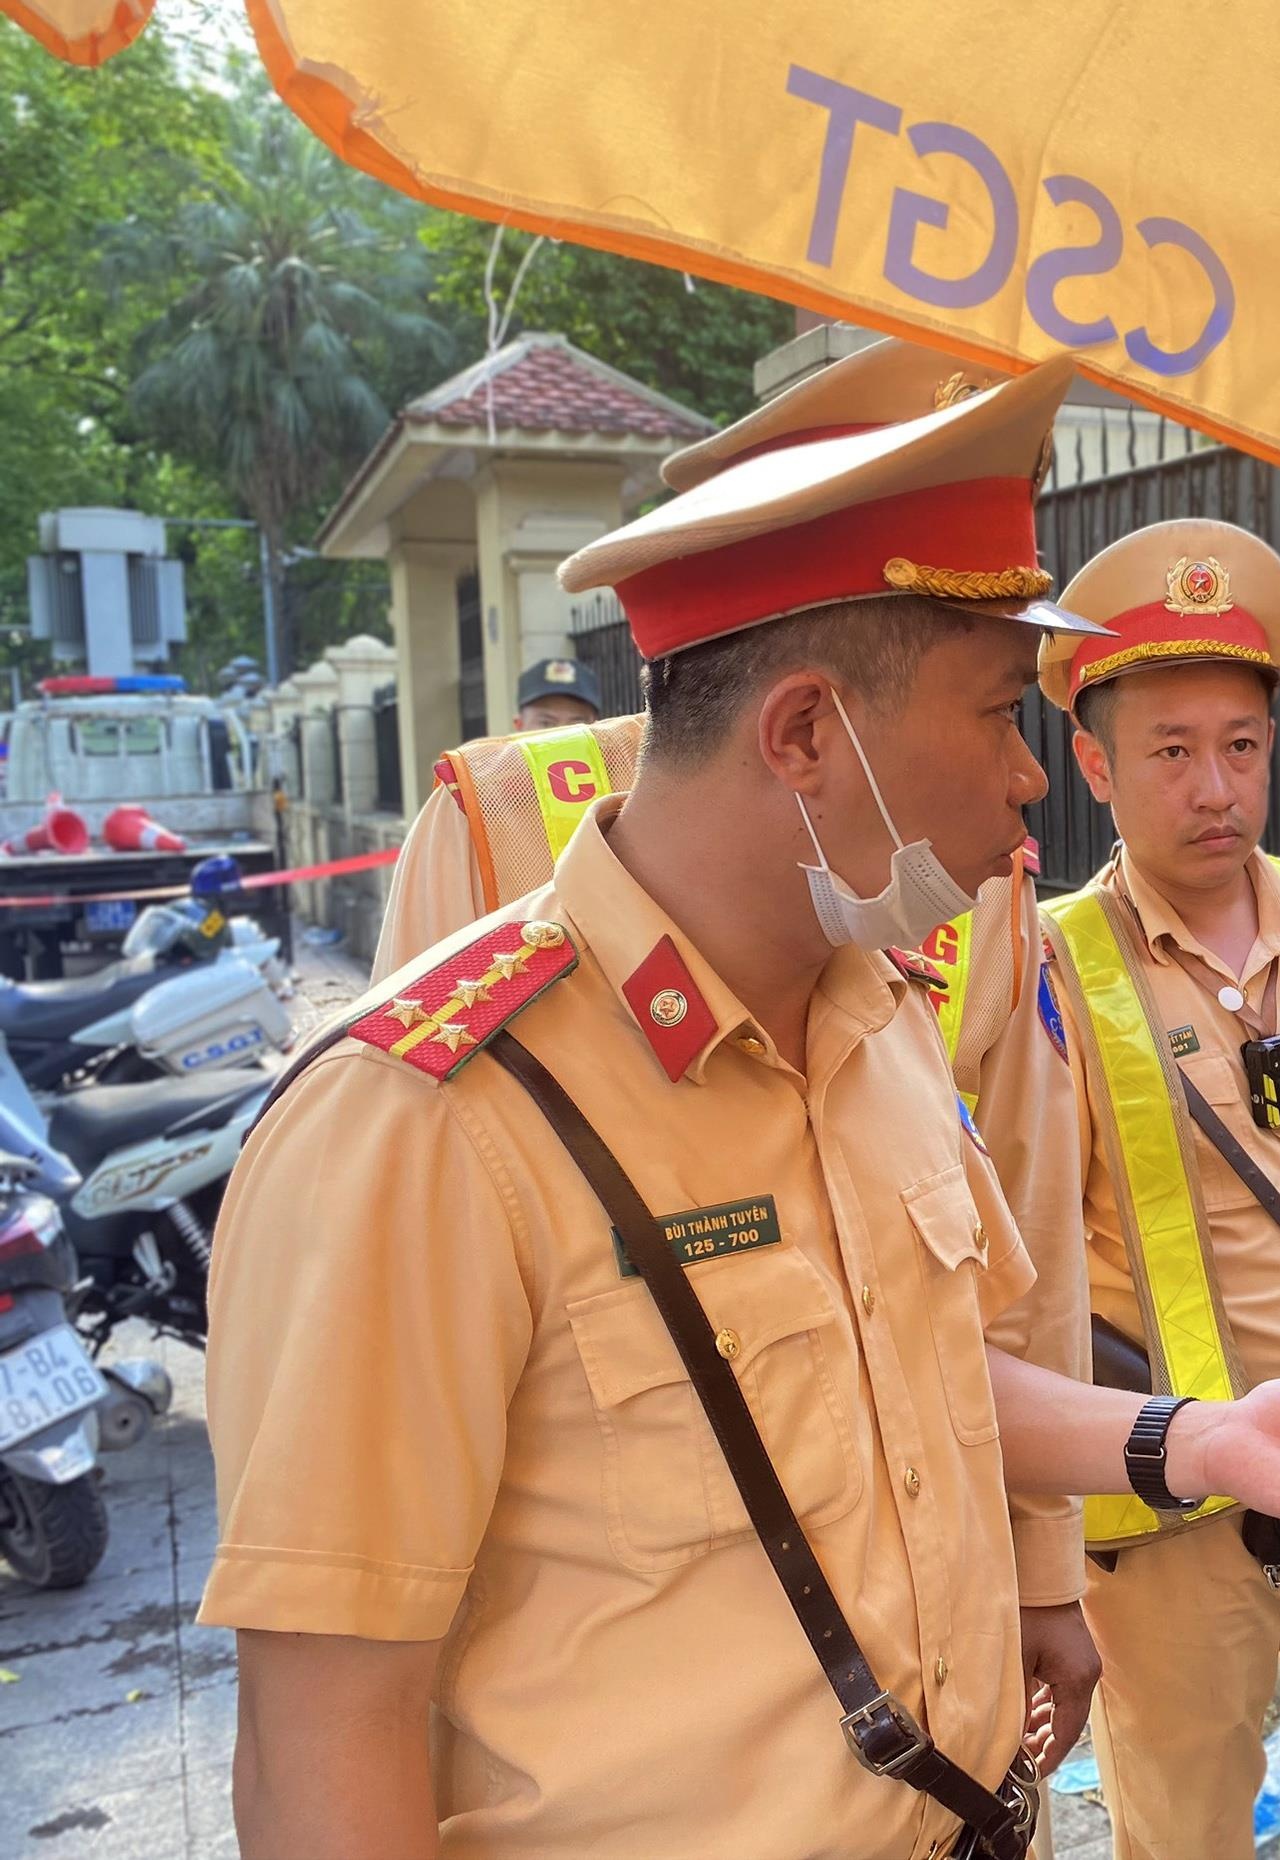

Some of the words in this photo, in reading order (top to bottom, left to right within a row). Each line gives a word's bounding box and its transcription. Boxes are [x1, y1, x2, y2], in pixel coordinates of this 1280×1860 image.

[665, 1223, 687, 1241] BÙI
[688, 1215, 728, 1236] THÀNH
[729, 1206, 769, 1227] TUYÊN
[684, 1238, 715, 1257] 125
[728, 1228, 760, 1247] 700
